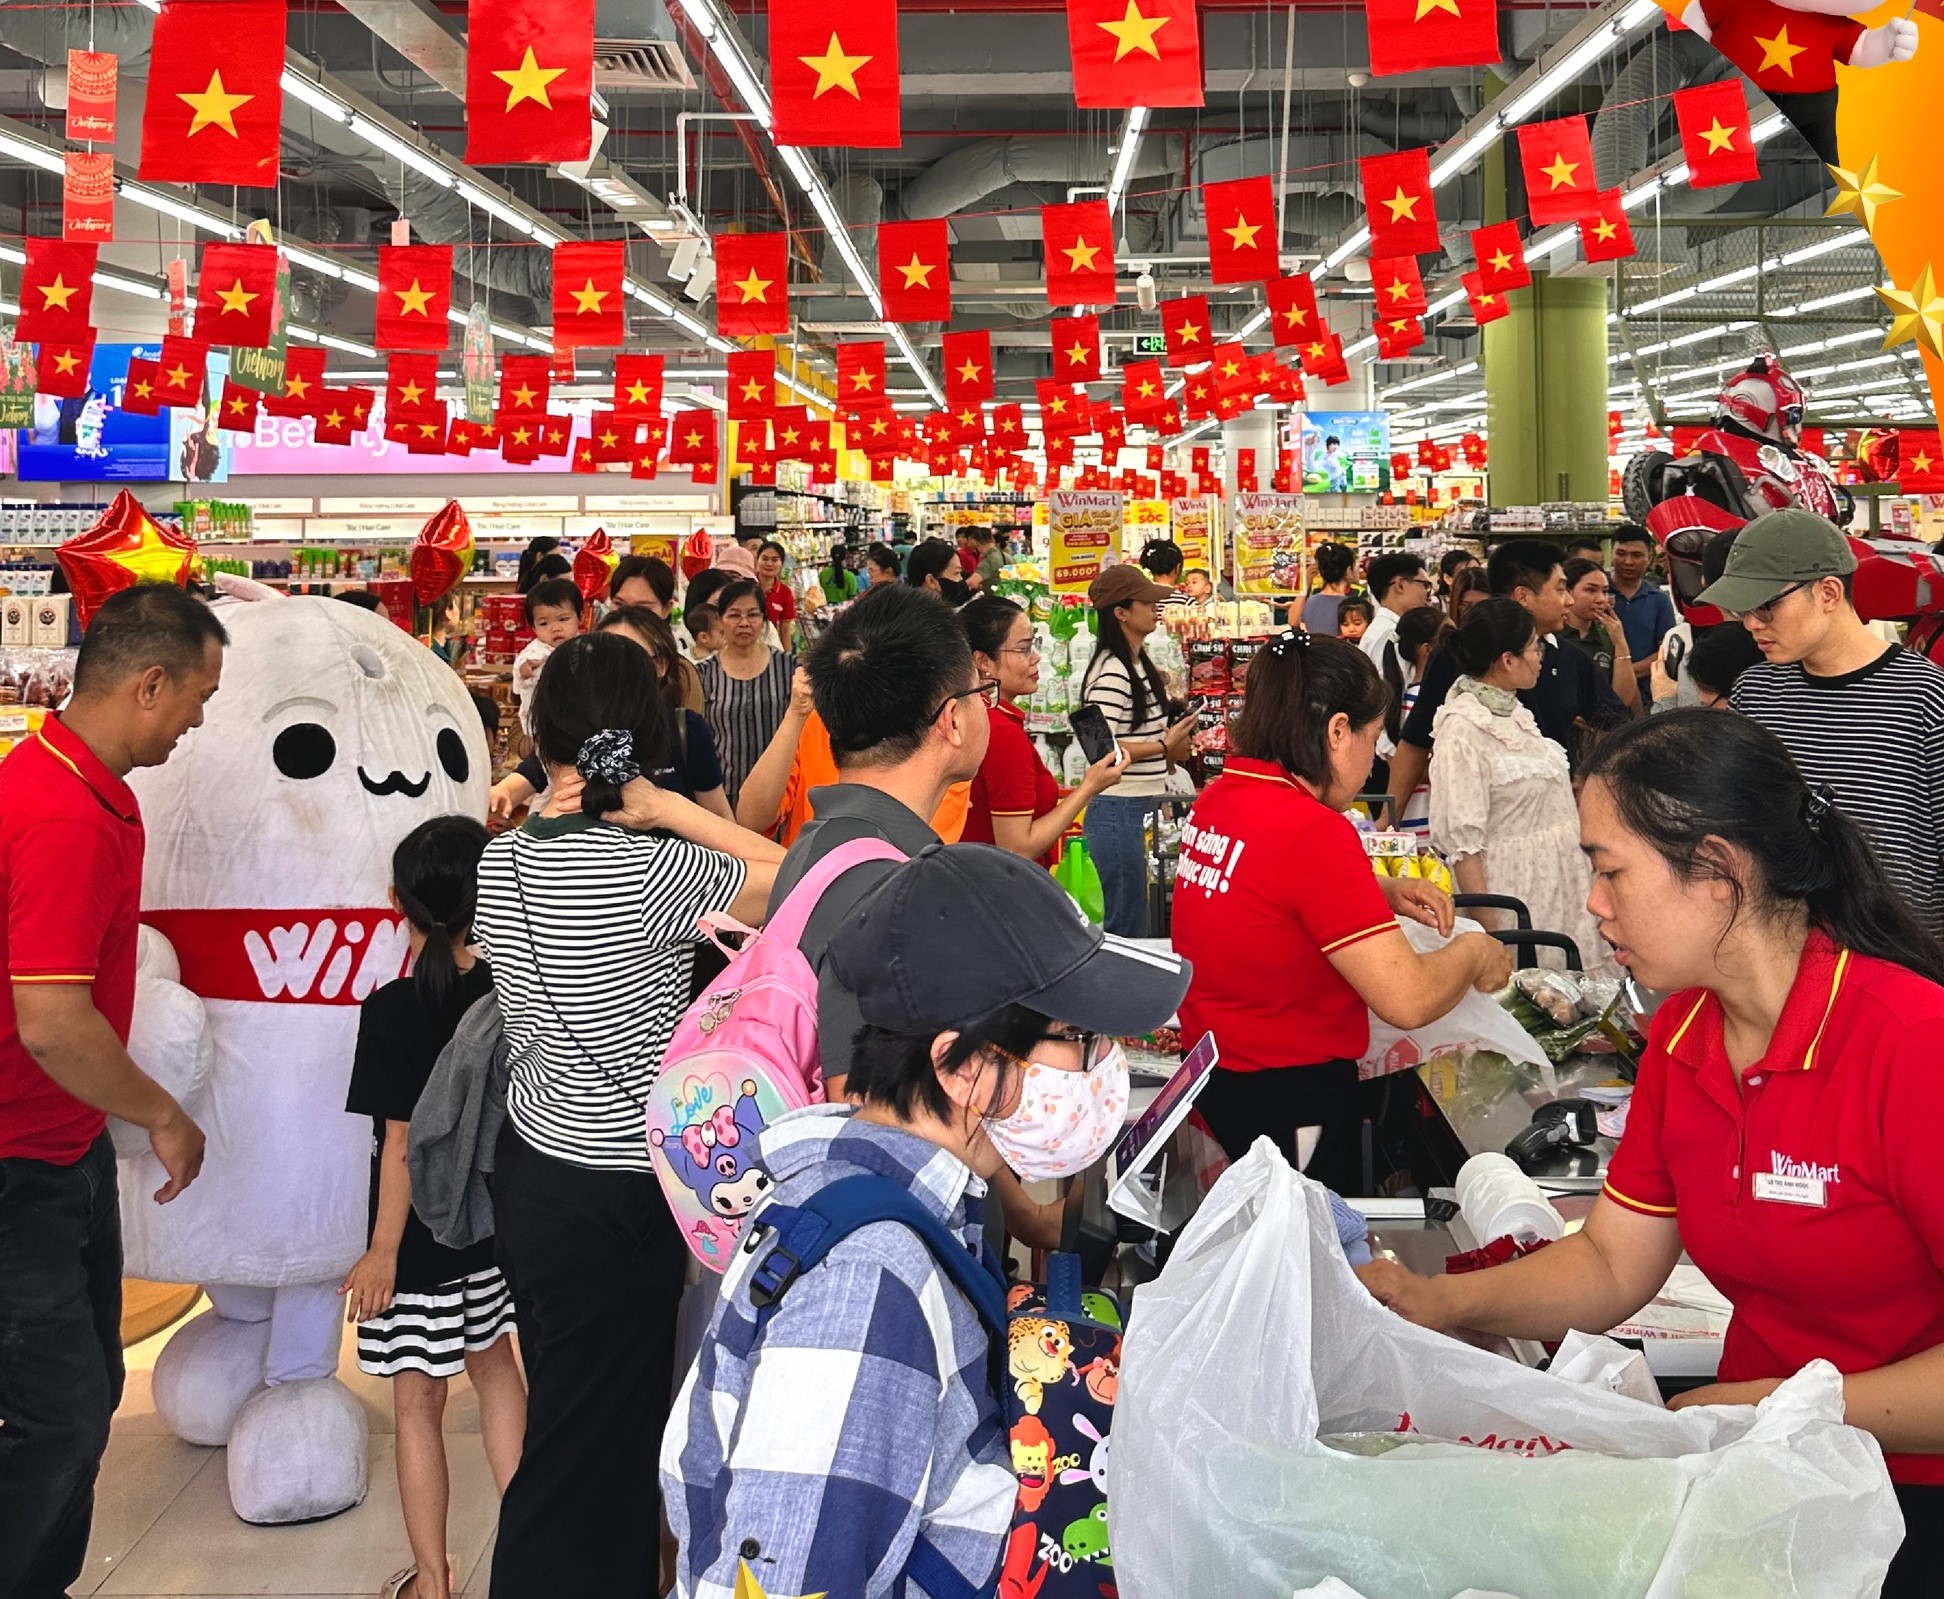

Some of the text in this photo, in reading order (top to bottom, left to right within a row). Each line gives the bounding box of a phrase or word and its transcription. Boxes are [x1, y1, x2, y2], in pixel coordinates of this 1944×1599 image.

[1058, 493, 1117, 508] WinMart
[1192, 642, 1224, 653] CHIN-SU
[670, 1085, 713, 1135] Love
[1771, 1149, 1841, 1183] WinMart
[1053, 1452, 1081, 1475] ZOO
[1038, 1532, 1073, 1574] ZOO
